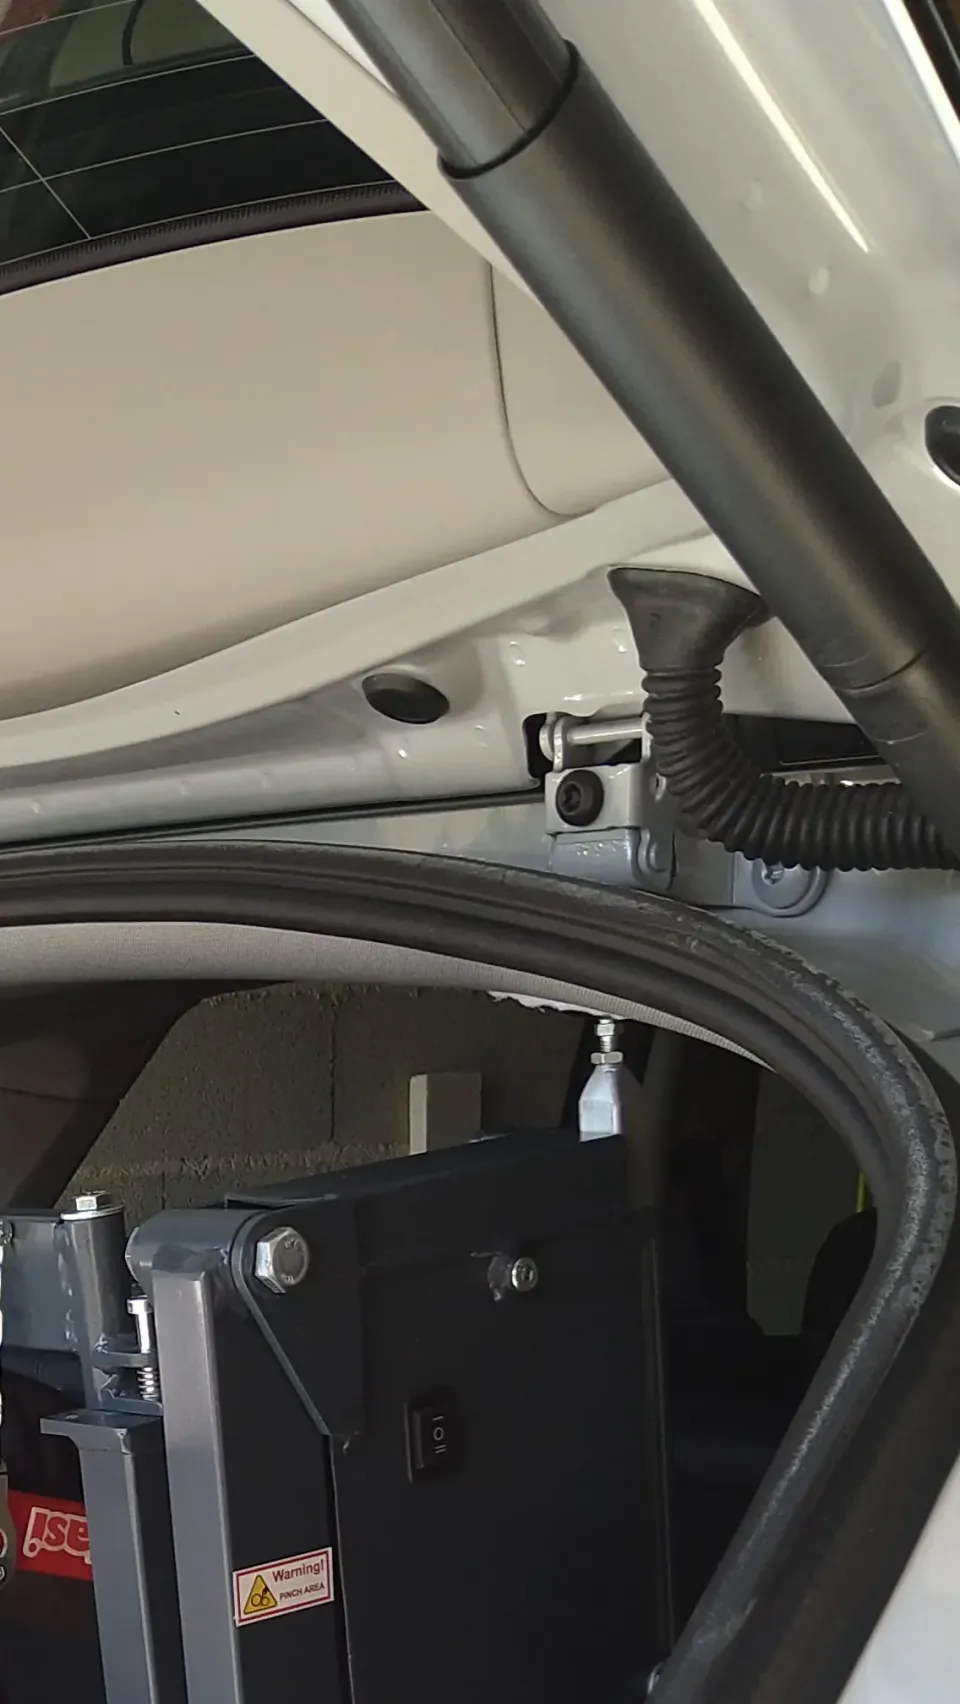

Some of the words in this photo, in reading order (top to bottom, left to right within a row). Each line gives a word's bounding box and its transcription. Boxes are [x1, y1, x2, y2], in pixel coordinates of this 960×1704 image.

[272, 1559, 324, 1583] Warning!
[279, 1589, 302, 1601] PINCH
[304, 1582, 325, 1594] AREA
